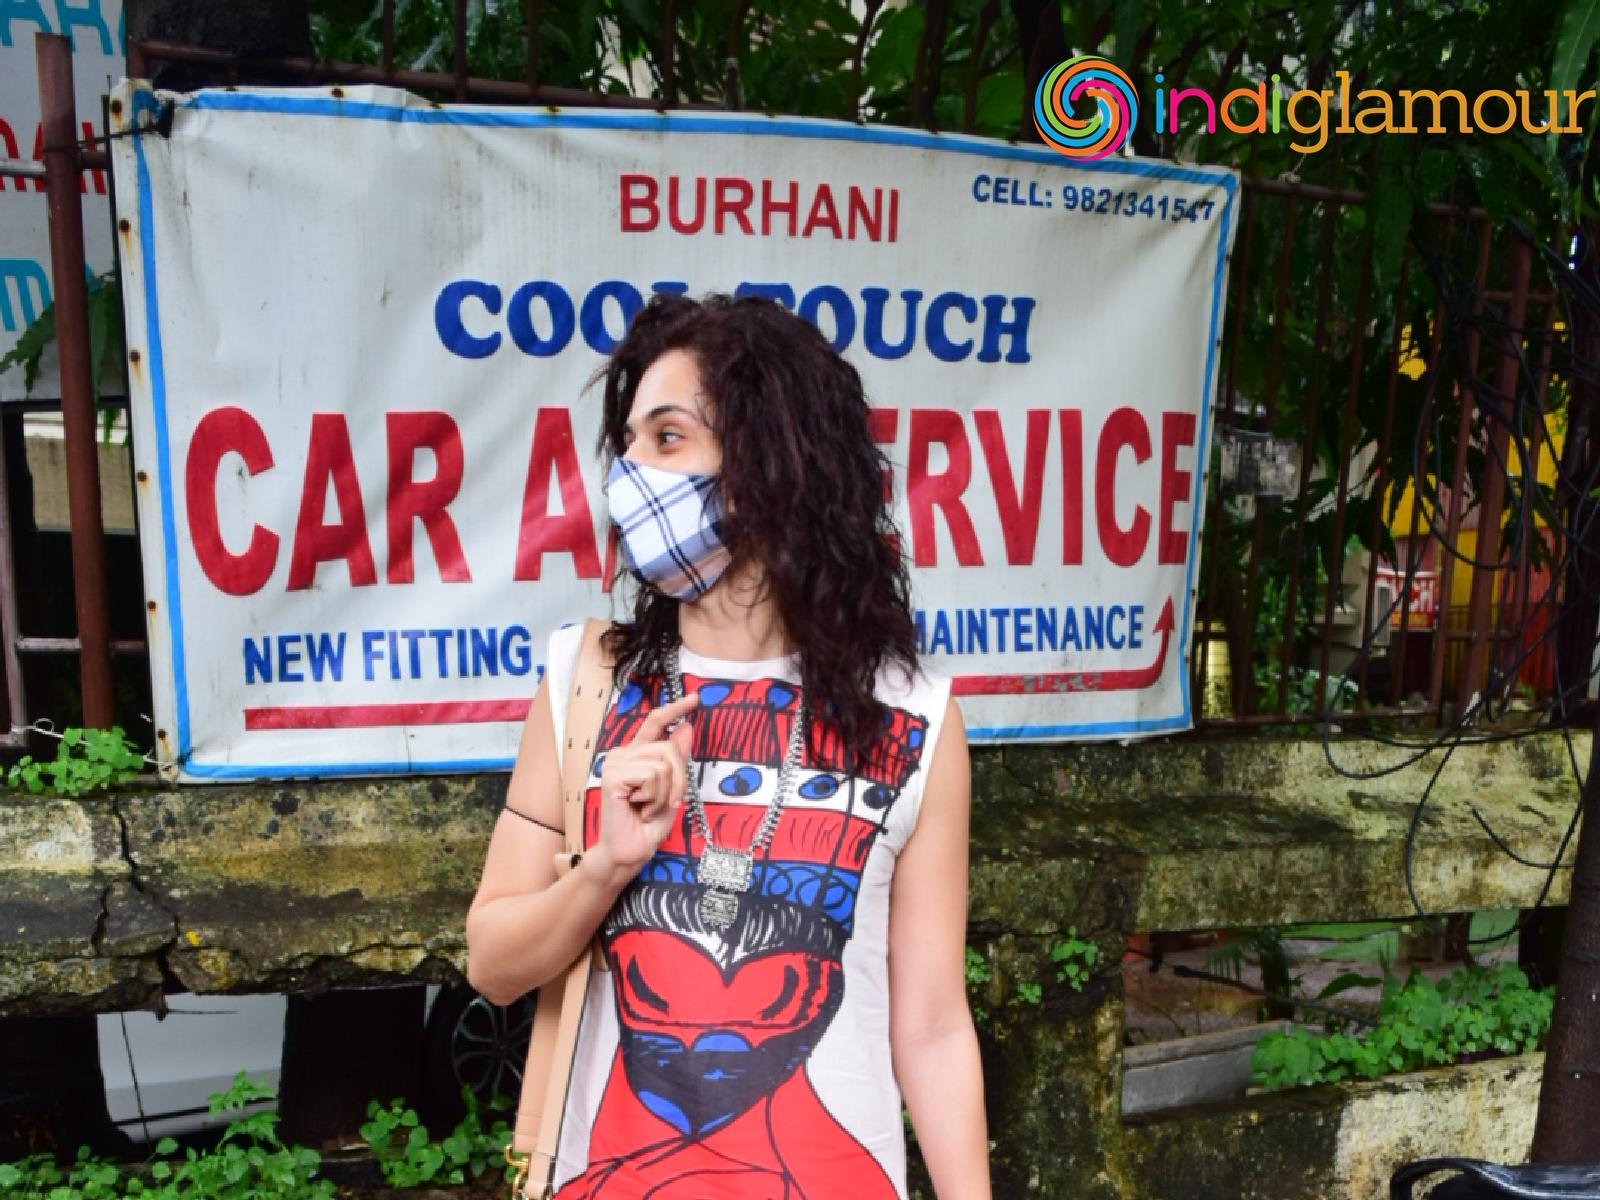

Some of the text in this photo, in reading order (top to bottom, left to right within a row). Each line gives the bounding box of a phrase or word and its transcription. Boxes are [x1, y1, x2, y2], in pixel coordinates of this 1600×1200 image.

[620, 174, 899, 242] BURHANI
[972, 173, 1215, 223] CELL: 9821341547
[434, 278, 1036, 363] COO OUCH
[185, 406, 471, 597] CAR
[868, 406, 1196, 568] RVICE
[243, 629, 347, 685] NEW
[361, 621, 545, 684] FITTING,
